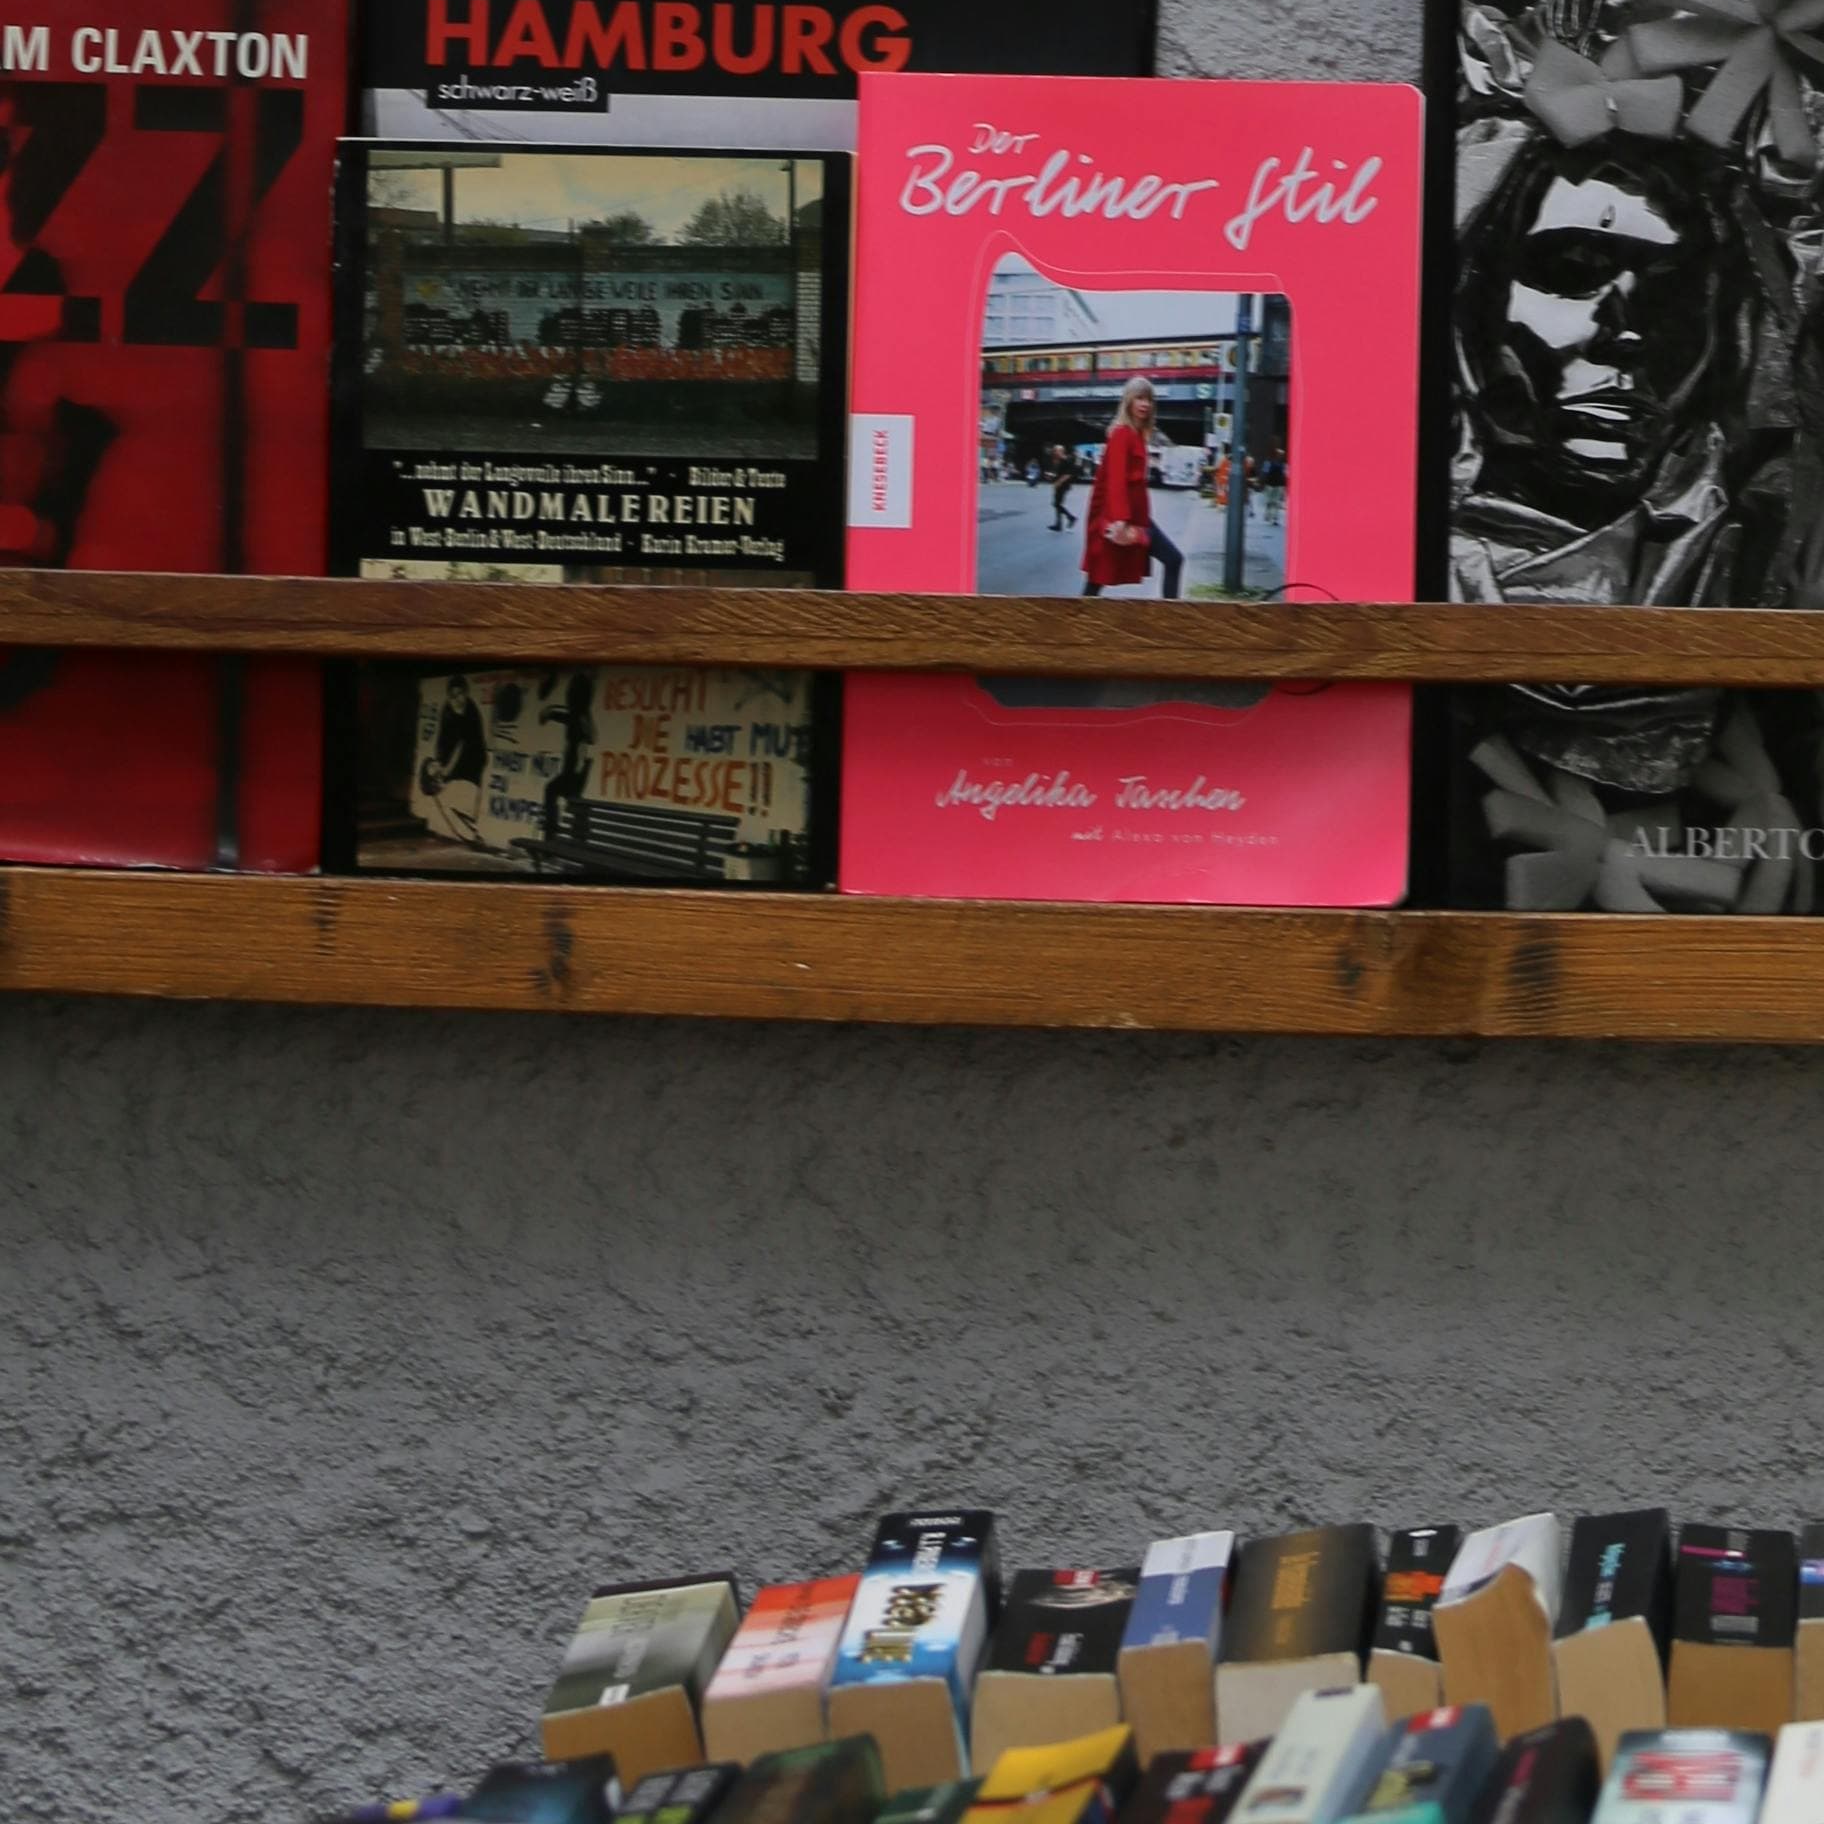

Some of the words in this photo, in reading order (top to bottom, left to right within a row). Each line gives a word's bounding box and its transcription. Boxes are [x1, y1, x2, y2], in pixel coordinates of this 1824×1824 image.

[72, 27, 308, 79] CLAXTON
[438, 74, 598, 103] schwarz-weiß
[969, 123, 1039, 155] Der
[901, 145, 1218, 219] Berliner
[872, 428, 889, 512] KNESEBECK
[422, 489, 755, 526] WANDMALEREIEN
[936, 769, 1097, 820] Angelika
